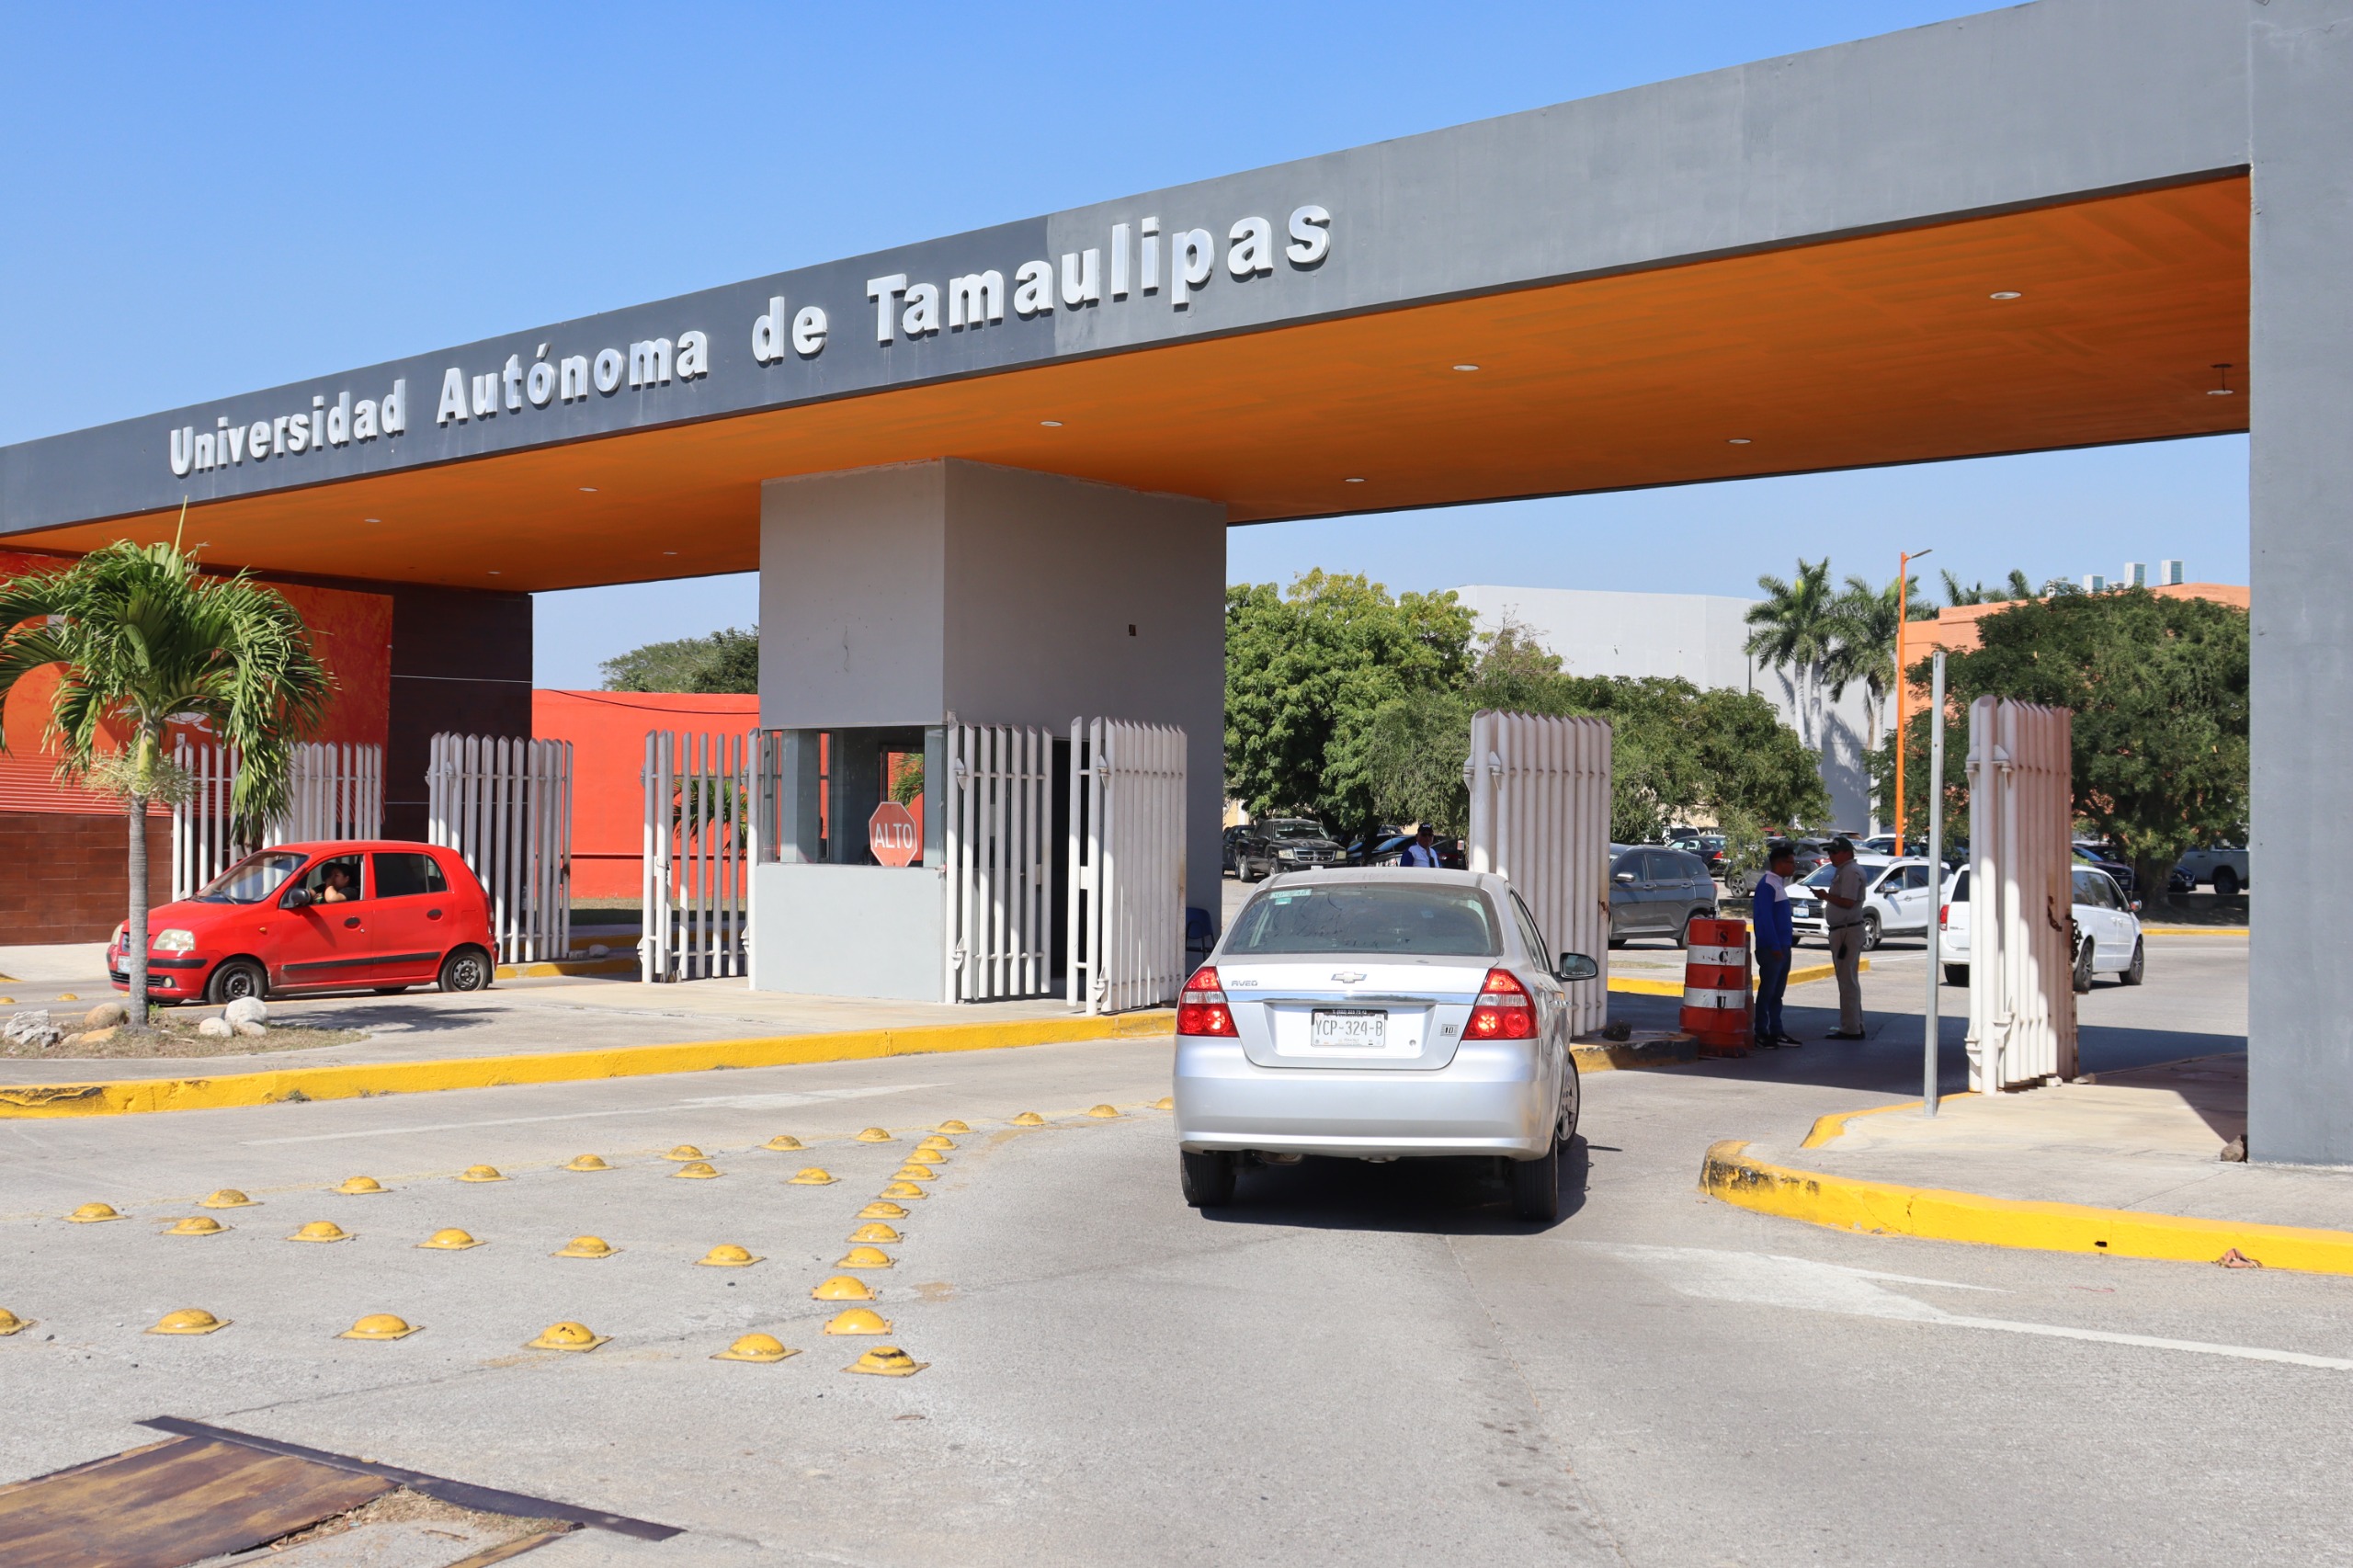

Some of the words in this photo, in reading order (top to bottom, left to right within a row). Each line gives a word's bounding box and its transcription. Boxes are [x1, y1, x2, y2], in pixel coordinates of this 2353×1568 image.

[170, 379, 405, 476] Universidad
[436, 330, 708, 424] Autónoma
[752, 295, 827, 361] de
[867, 204, 1331, 342] Tamaulipas
[874, 823, 913, 849] ALTO
[1315, 1019, 1383, 1037] YCP-324-B
